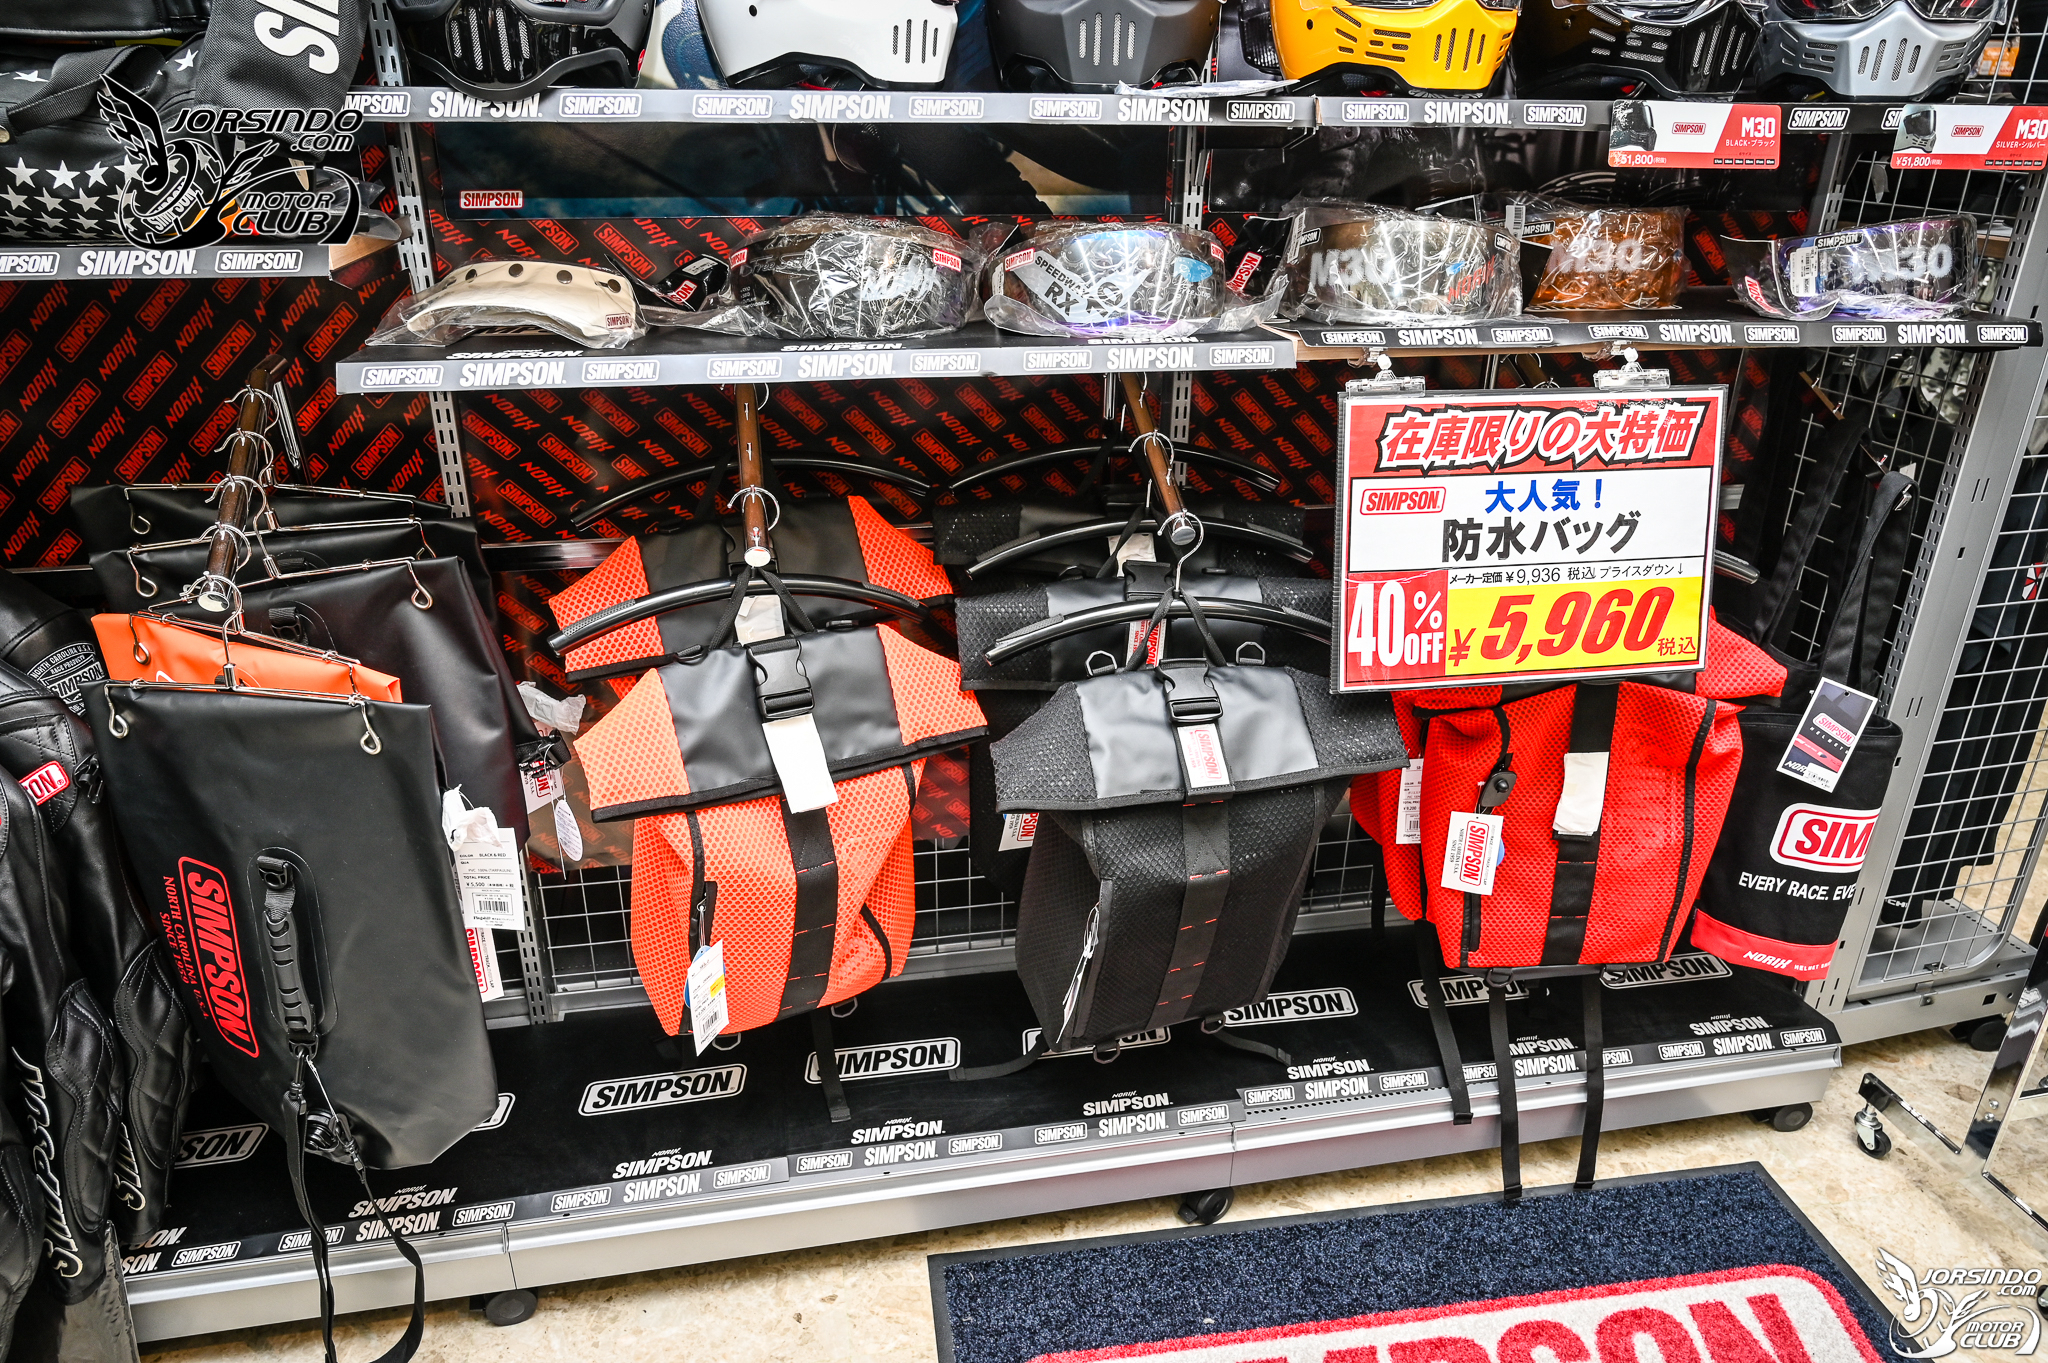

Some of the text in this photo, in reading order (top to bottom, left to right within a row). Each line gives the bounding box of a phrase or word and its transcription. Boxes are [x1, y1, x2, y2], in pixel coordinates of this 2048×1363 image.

[1741, 117, 1776, 138] M30
[2015, 118, 2048, 140] M30
[597, 224, 655, 277] SIMPSON
[933, 251, 961, 270] SIMPSON
[1695, 230, 1726, 271] SIMPSON
[1817, 233, 1860, 248] SIMPSON
[28, 281, 69, 332] NORIX
[1044, 281, 1080, 317] RX
[174, 302, 214, 354] NORIX
[307, 305, 355, 359] SIMPSON
[98, 328, 138, 381] NORIX
[50, 381, 98, 436] SIMPSON
[484, 393, 541, 431] NORIX
[583, 391, 637, 434] SIMPSON
[776, 389, 824, 432] SIMPSON
[869, 390, 917, 427] NORIX
[1258, 374, 1297, 409] NORIX
[86, 407, 126, 459] NORIX
[326, 404, 367, 456] NORIX
[656, 410, 709, 455] SIMPSON
[1383, 404, 1704, 466] 在庫限りの大特価
[11, 435, 52, 486] NORIX
[540, 436, 595, 480] SIMPSON
[916, 432, 961, 473] SIMPSON
[1273, 436, 1312, 469] NORIX
[41, 460, 87, 512] SIMPSON
[499, 482, 554, 526] SIMPSON
[1441, 511, 1642, 563] 防水バッグ
[1347, 579, 1443, 667] 40 %
[49, 647, 78, 664] CAROLINA
[1404, 631, 1444, 666] OFF
[1657, 636, 1697, 656] 税込
[1818, 717, 1853, 743] SIMPSON
[1020, 812, 1039, 837] PSON
[1794, 818, 1879, 860] SIM
[1463, 825, 1486, 881] SIMPSON
[1738, 871, 1785, 893] EVERY
[159, 911, 190, 984] SINCE 1959
[163, 875, 179, 918] NORTH
[172, 918, 198, 986] CAROLINA
[187, 871, 249, 1051] SIMPSON
[1742, 950, 1793, 970] NORIX
